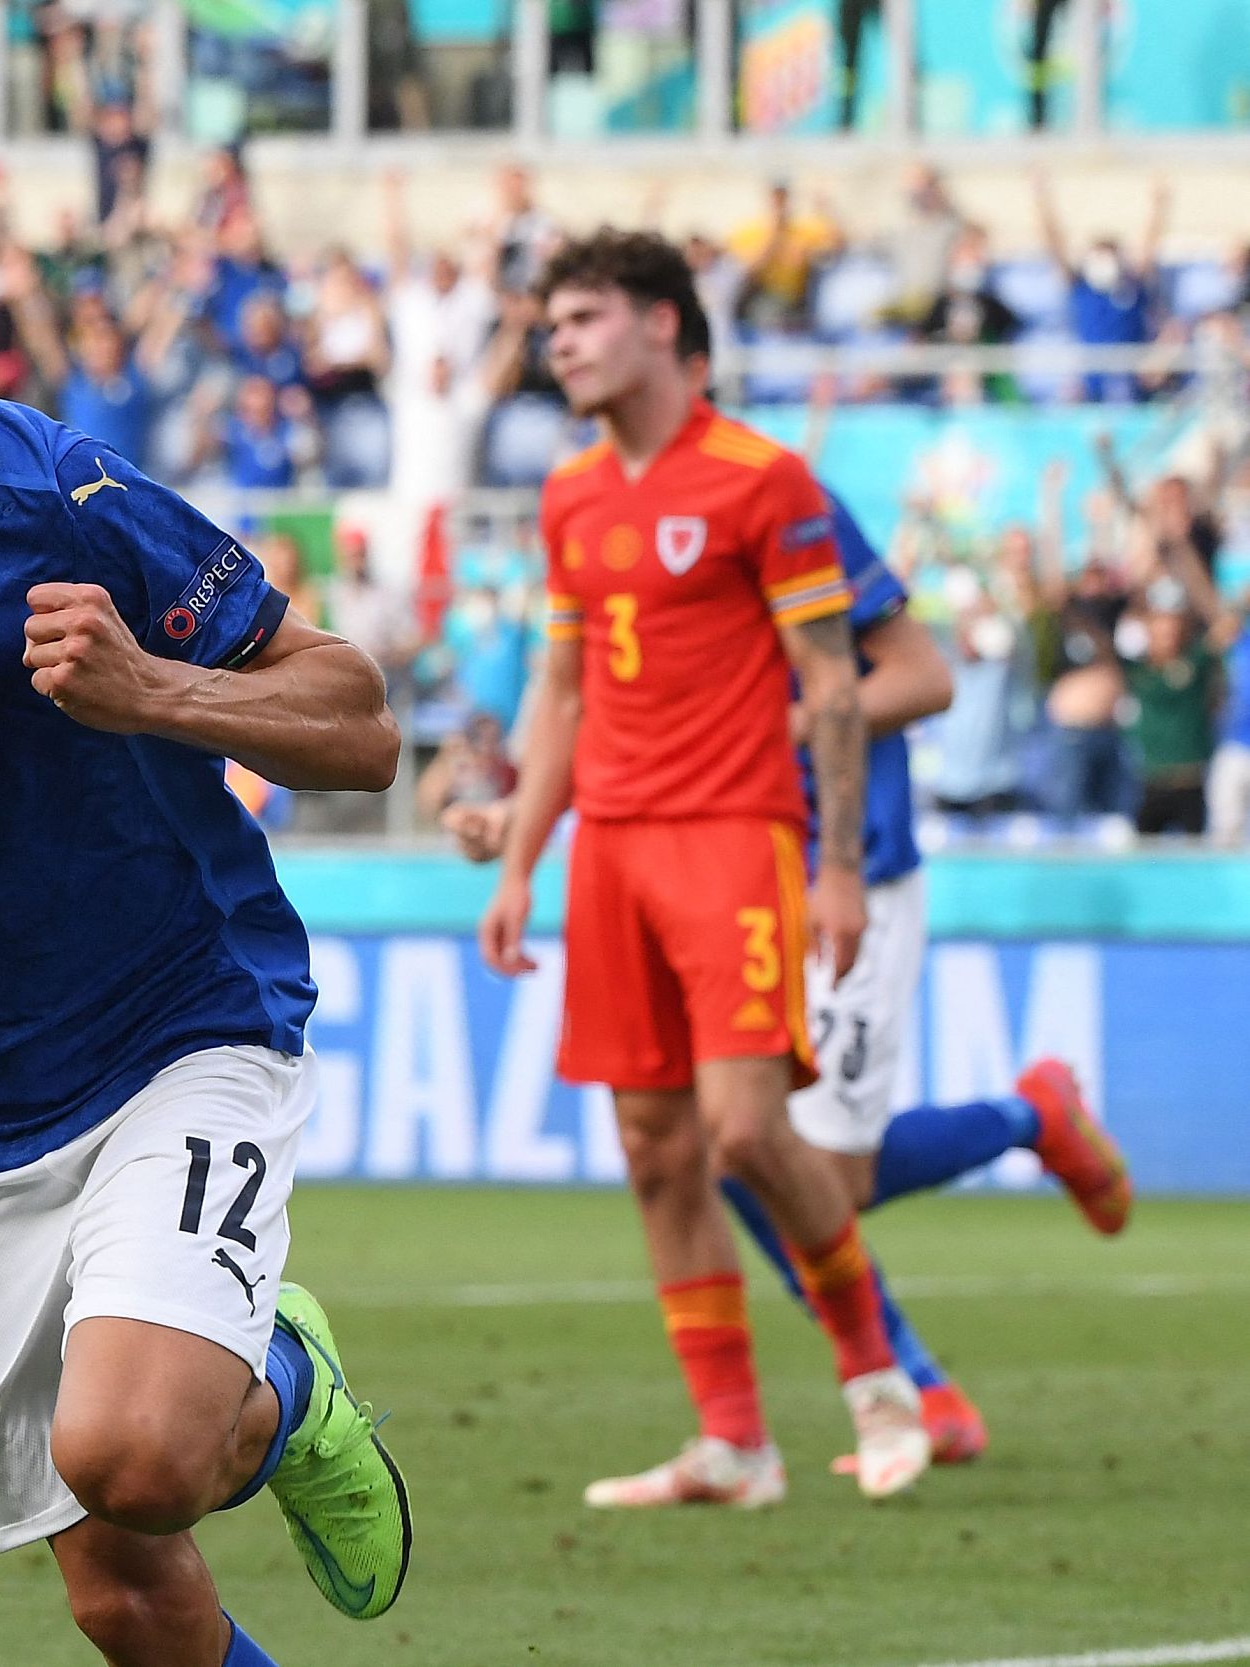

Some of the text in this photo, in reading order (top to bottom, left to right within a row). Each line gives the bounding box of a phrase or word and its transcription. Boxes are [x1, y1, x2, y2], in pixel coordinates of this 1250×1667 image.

[188, 544, 243, 614] RESPECT
[604, 591, 643, 684] 3
[736, 906, 783, 993] 3
[178, 1135, 267, 1254] 12
